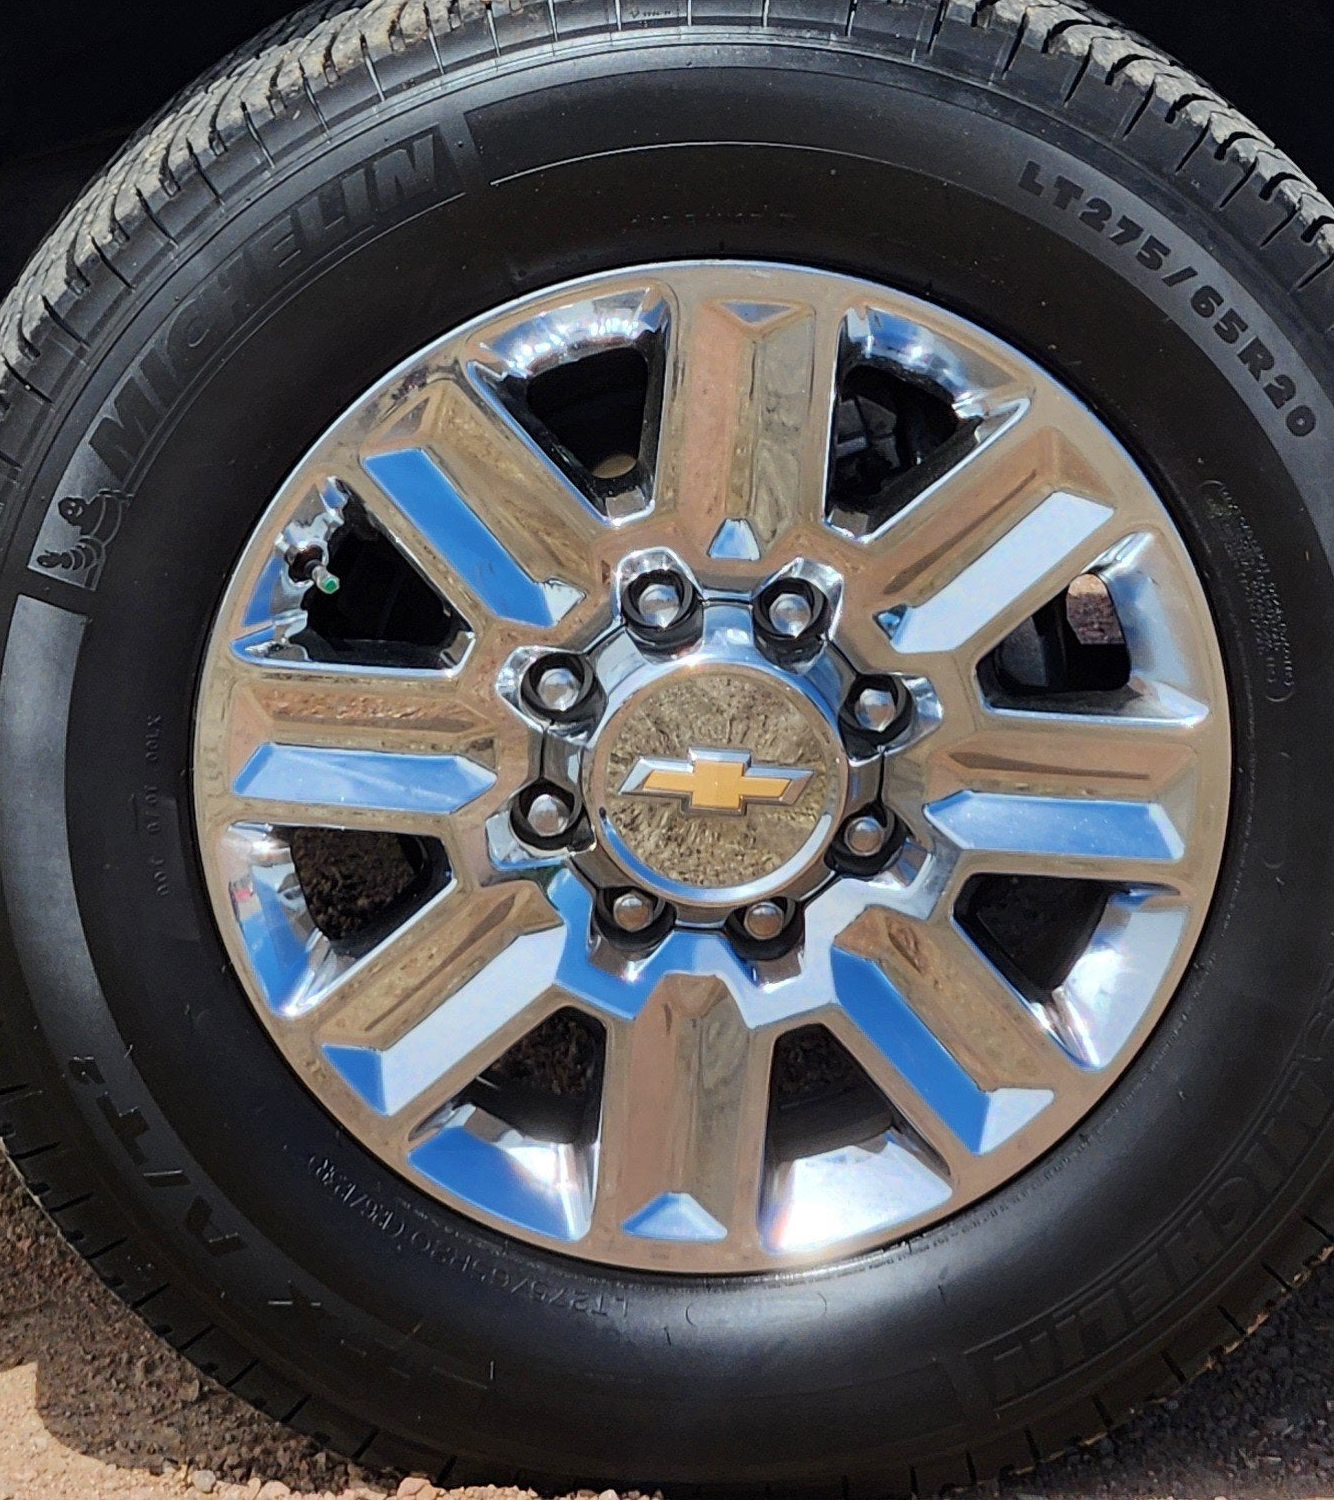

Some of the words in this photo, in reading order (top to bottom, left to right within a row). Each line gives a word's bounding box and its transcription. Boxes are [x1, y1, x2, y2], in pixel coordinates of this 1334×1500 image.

[86, 131, 443, 484] MICHELIN
[1017, 160, 1317, 438] LT275/65R20
[991, 1066, 1334, 1400] MICHELIN
